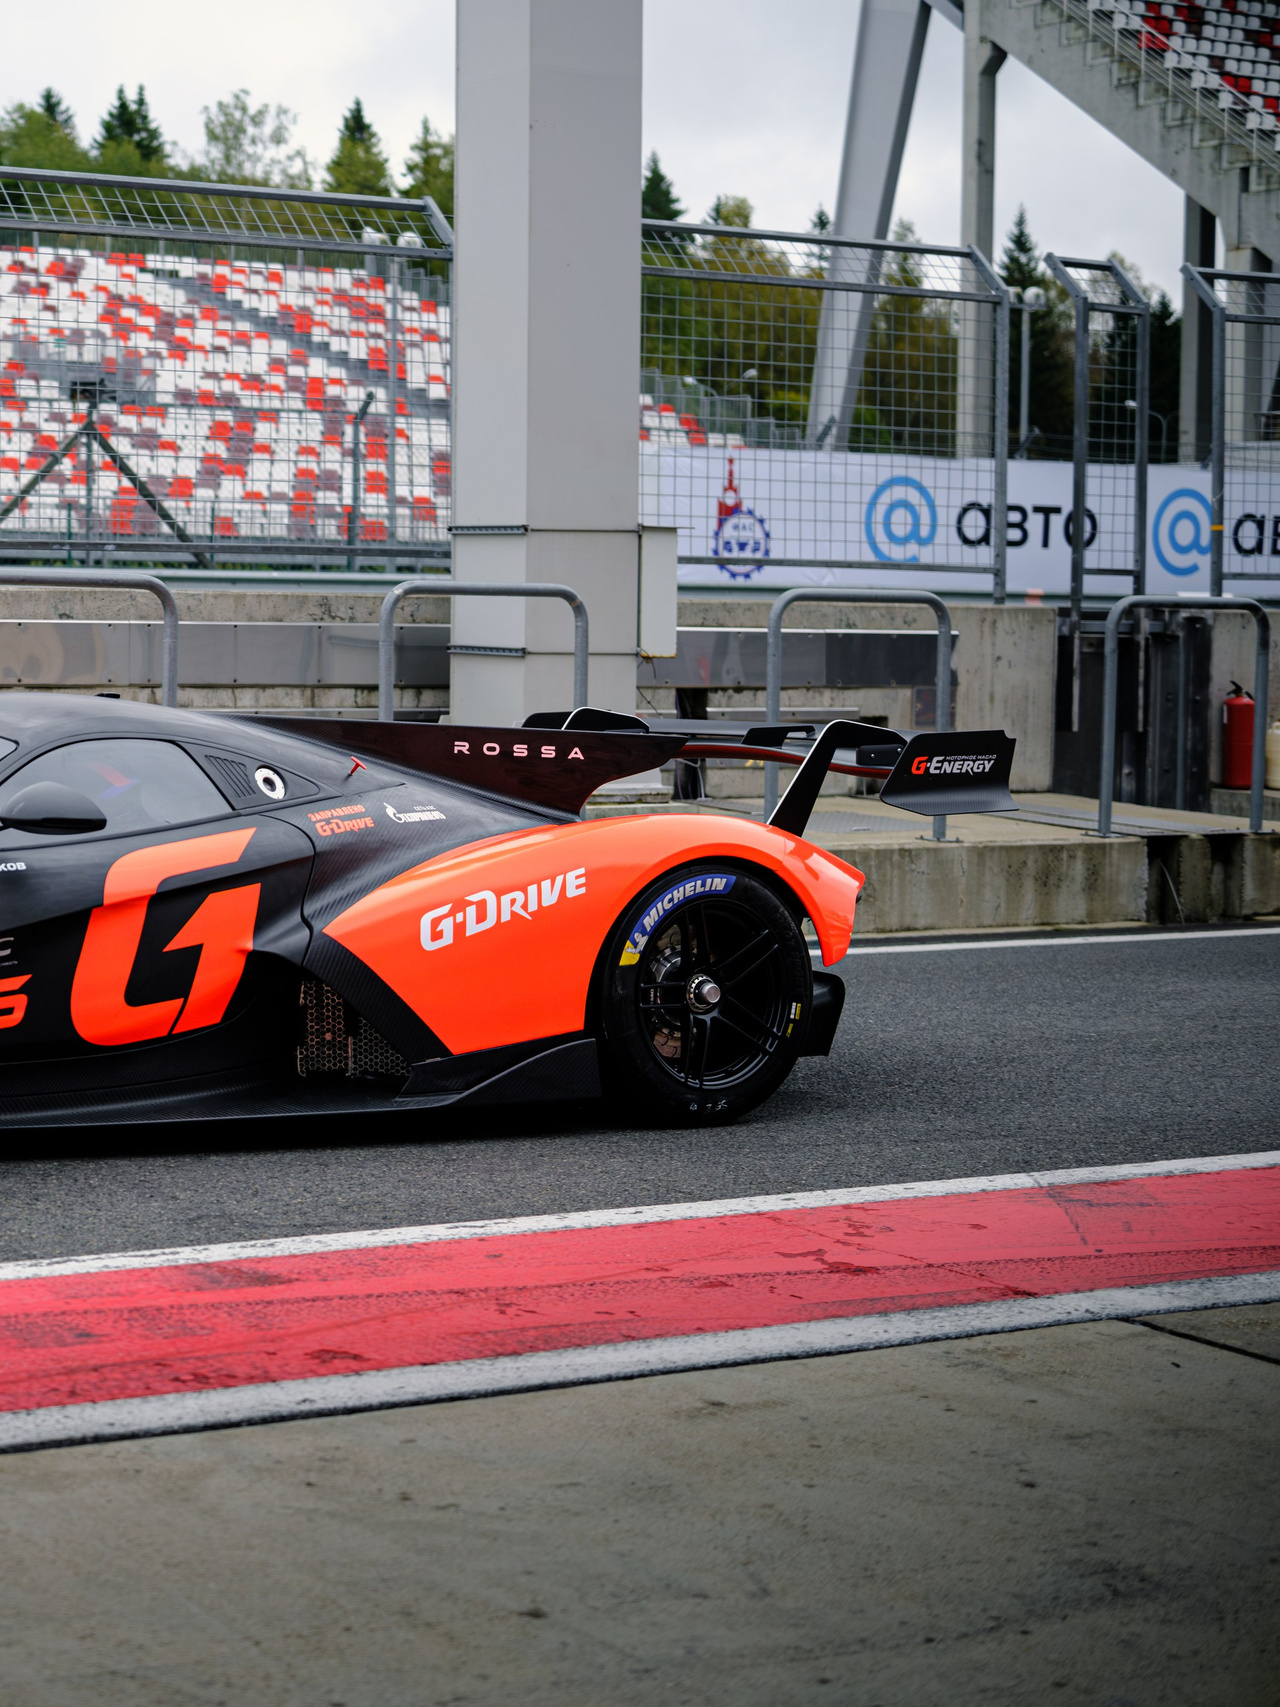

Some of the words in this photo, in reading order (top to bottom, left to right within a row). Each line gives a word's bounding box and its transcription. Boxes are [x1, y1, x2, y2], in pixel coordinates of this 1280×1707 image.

[956, 502, 1097, 549] авто
[453, 741, 585, 760] ROSSA
[307, 804, 366, 822] ЗАПРАВЛЕНО
[643, 877, 727, 932] MICHELIN
